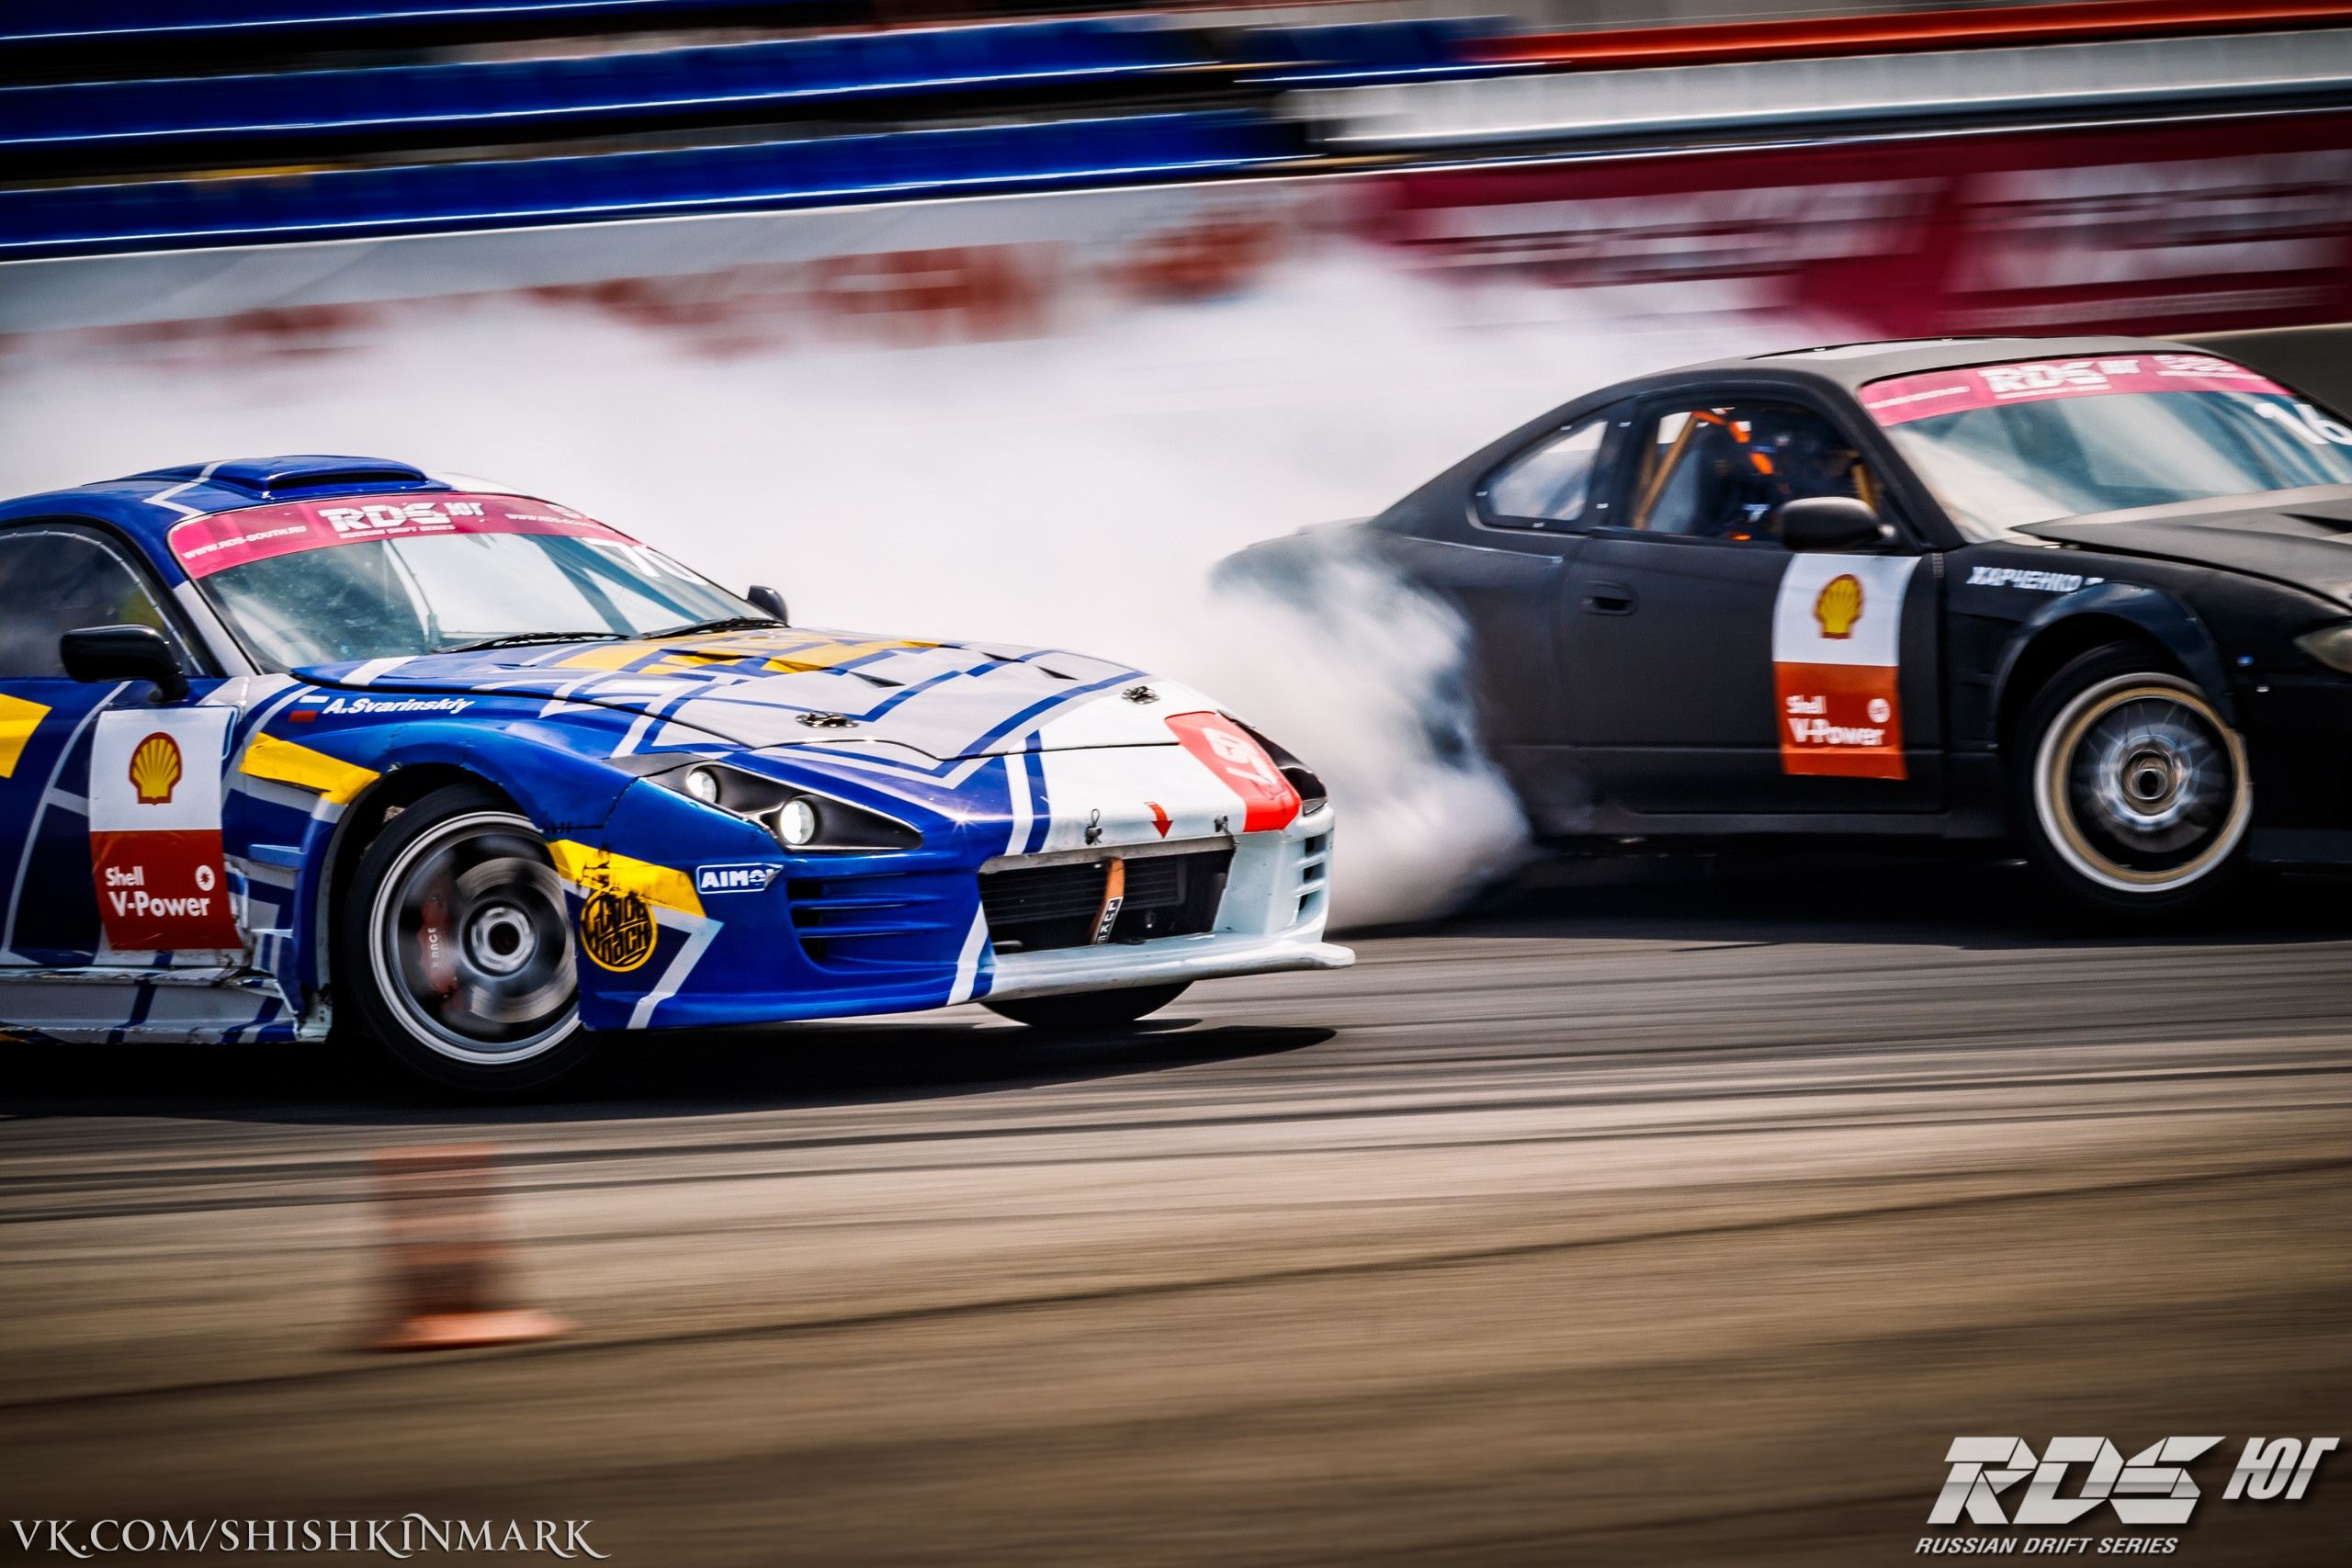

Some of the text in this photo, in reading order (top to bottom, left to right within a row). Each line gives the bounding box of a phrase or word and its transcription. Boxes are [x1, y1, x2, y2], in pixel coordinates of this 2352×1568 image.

[318, 502, 451, 532] RDS
[322, 698, 476, 714] A.Svarinskiy
[1785, 694, 1827, 715] Shell
[1787, 717, 1885, 746] V-Power
[105, 865, 145, 886] Shell
[107, 890, 210, 917] V-Power
[1097, 901, 1117, 944] LUKE
